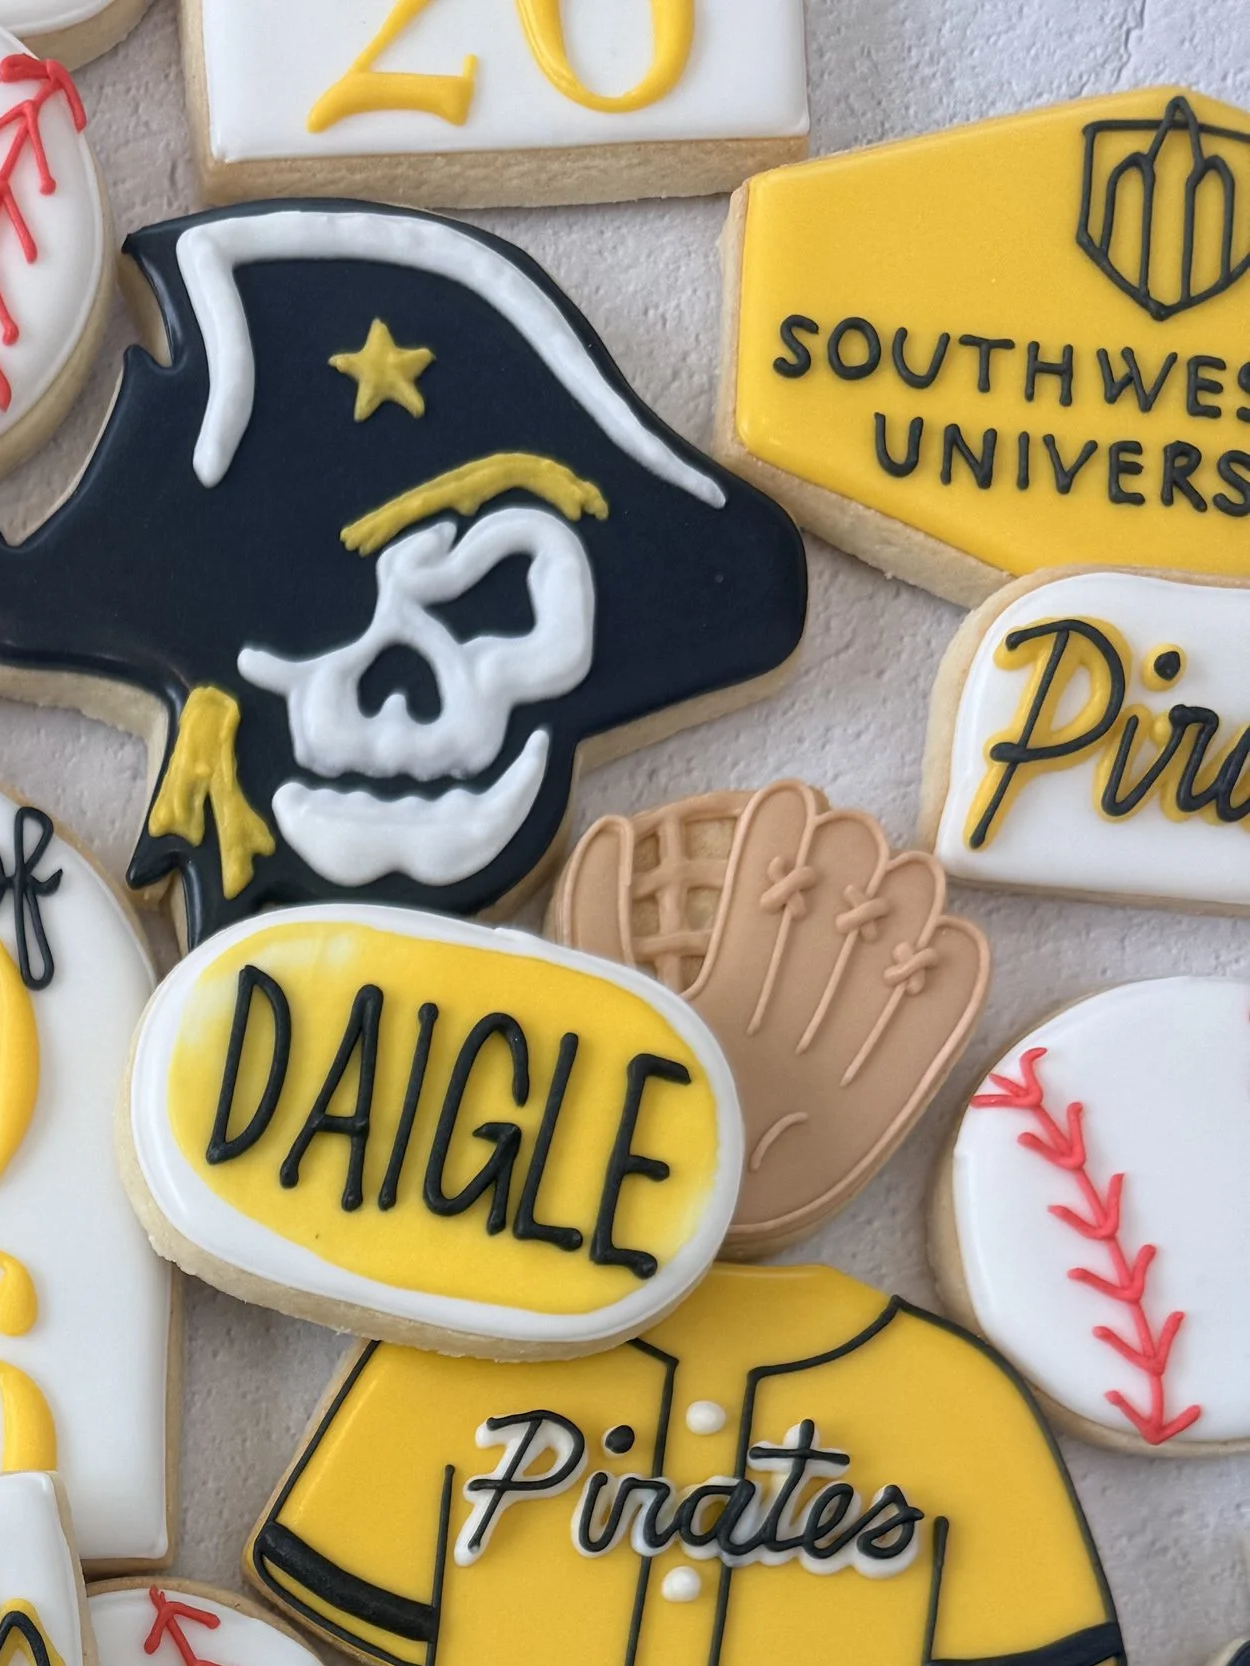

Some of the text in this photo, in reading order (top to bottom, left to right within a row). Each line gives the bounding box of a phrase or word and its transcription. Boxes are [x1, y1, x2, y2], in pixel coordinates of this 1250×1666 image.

[773, 313, 1250, 423] SOUTHWE
[874, 411, 1250, 518] UNIVERS
[205, 965, 692, 1281] DAIGLE
[466, 1409, 925, 1561] Pirates
